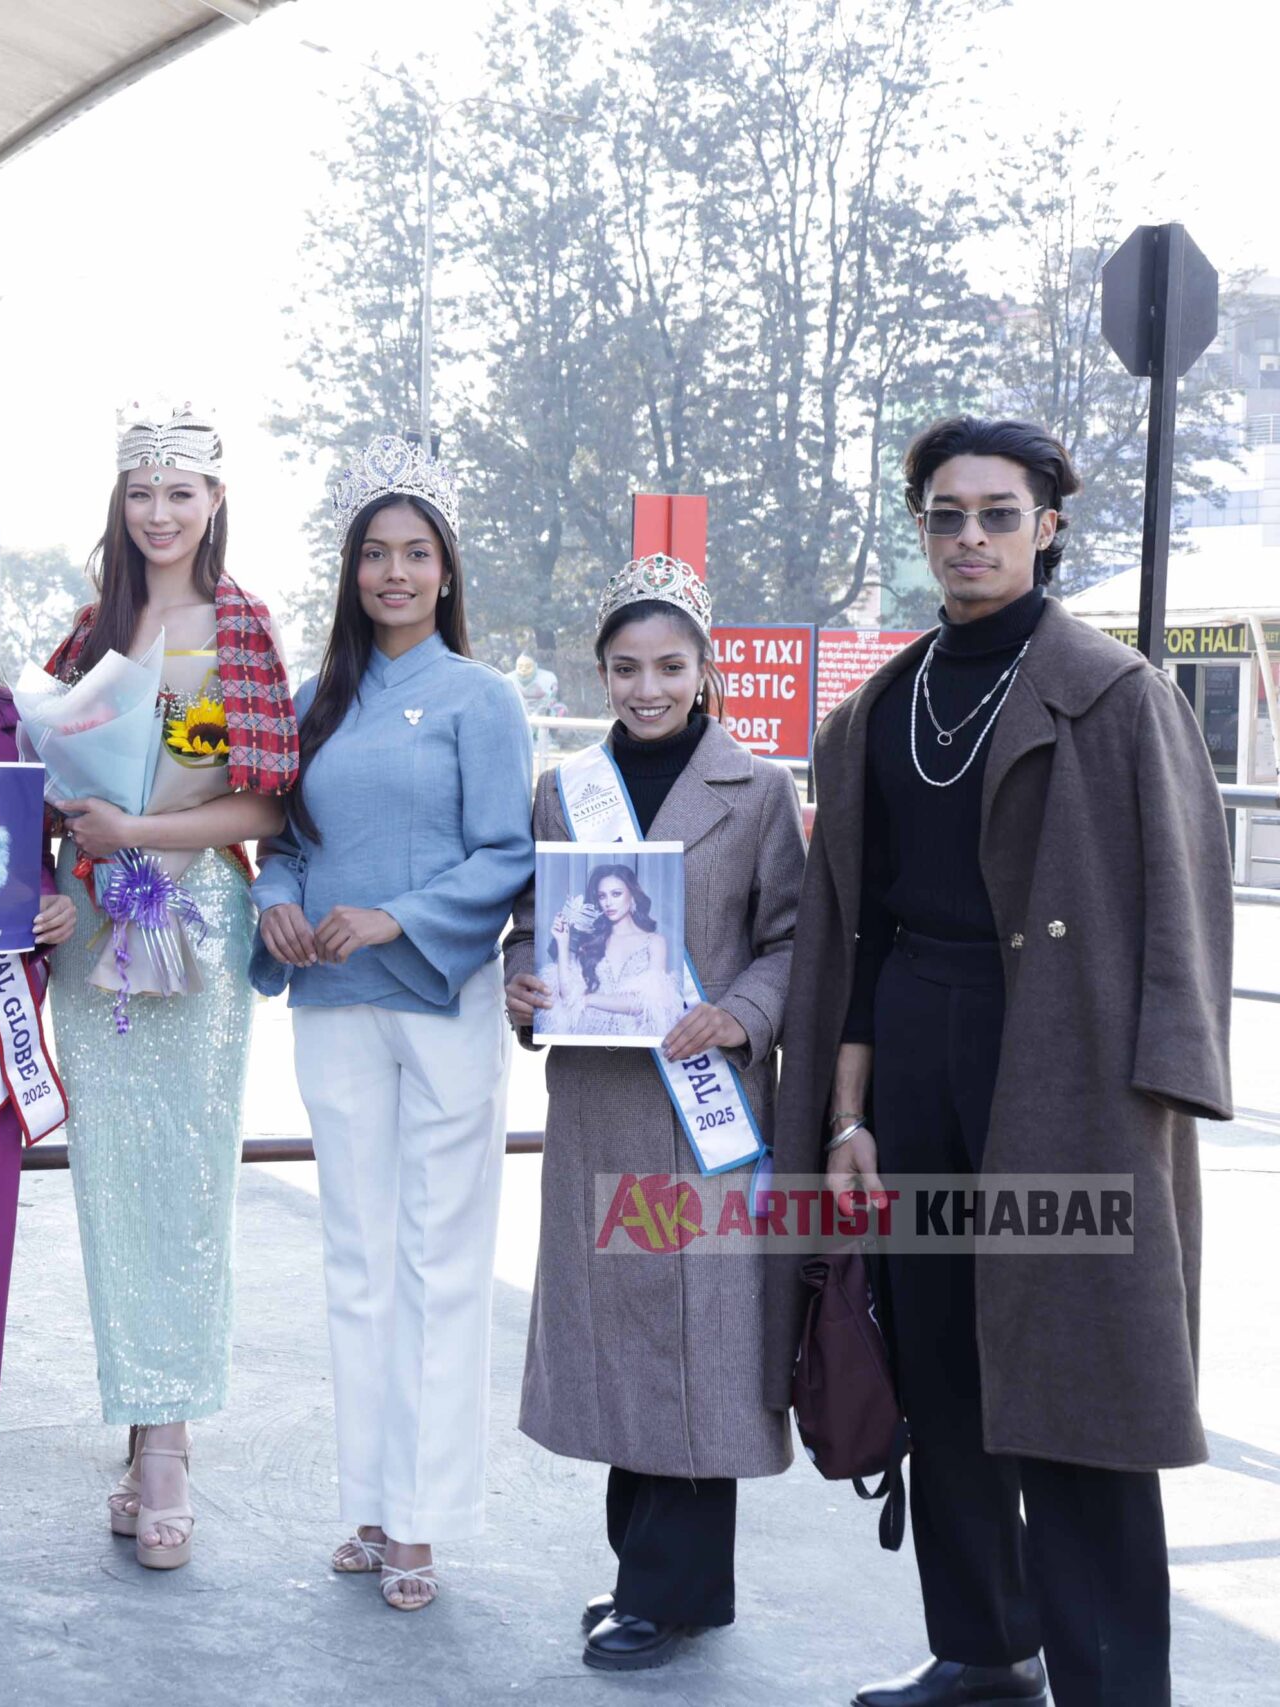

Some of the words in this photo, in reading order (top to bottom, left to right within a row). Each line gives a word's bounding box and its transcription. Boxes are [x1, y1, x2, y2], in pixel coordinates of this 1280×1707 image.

[713, 639, 746, 663] LIC
[752, 639, 803, 665] TAXI
[722, 672, 796, 700] ESTIC
[725, 717, 782, 740] PORT
[3, 997, 39, 1082] GLOBE
[681, 1054, 722, 1105] PAL
[22, 1080, 51, 1106] 2025
[696, 1106, 735, 1131] 2025
